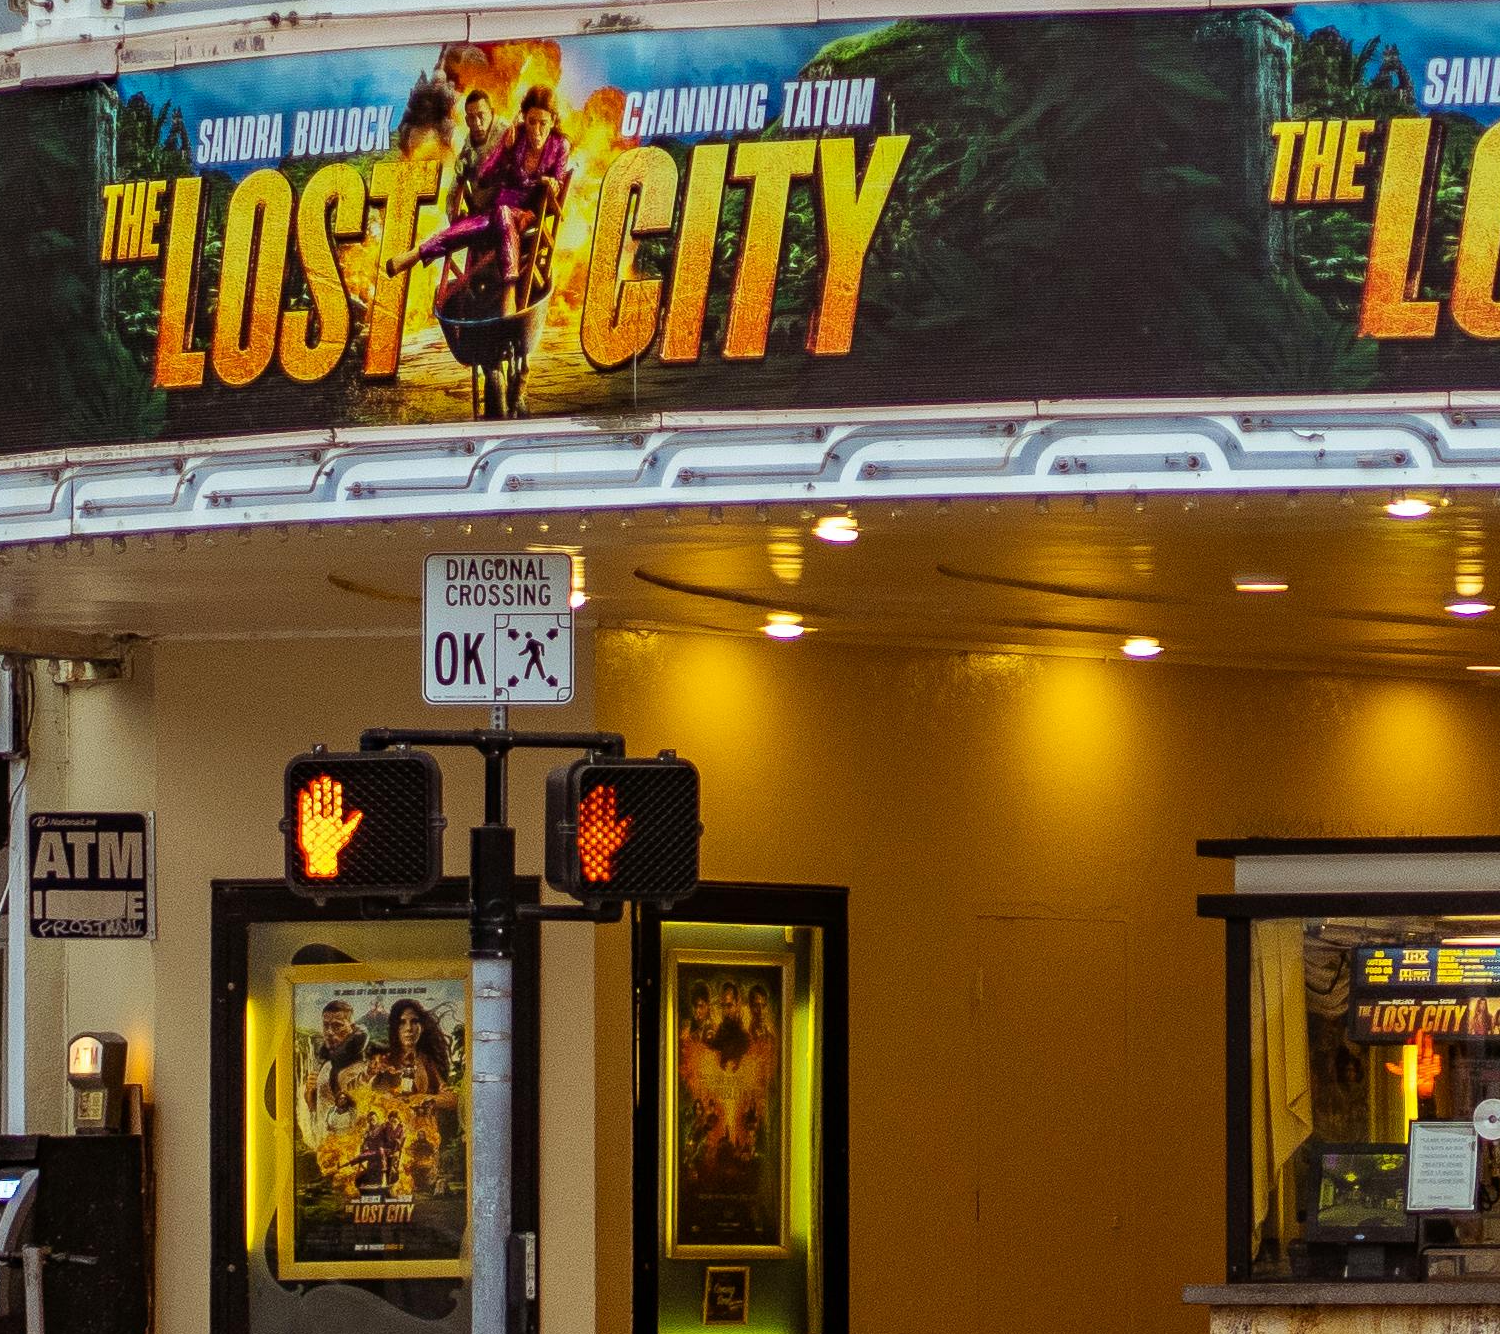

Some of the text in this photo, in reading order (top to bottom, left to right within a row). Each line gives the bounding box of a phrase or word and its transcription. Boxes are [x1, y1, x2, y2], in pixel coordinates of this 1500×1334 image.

[621, 76, 877, 137] CHANNING TATUM
[197, 103, 395, 164] SANDRA BULLOCK
[1270, 119, 1375, 203] THE
[100, 133, 912, 389] THE LOST CITY
[446, 558, 550, 581] DIAGONAL
[446, 584, 551, 606] CROSSING
[435, 631, 486, 686] OK
[33, 832, 143, 879] ATM
[1371, 1005, 1420, 1034] LOST
[1421, 1004, 1467, 1033] CITY
[354, 1204, 386, 1223] LOST
[386, 1204, 414, 1223] CITY
